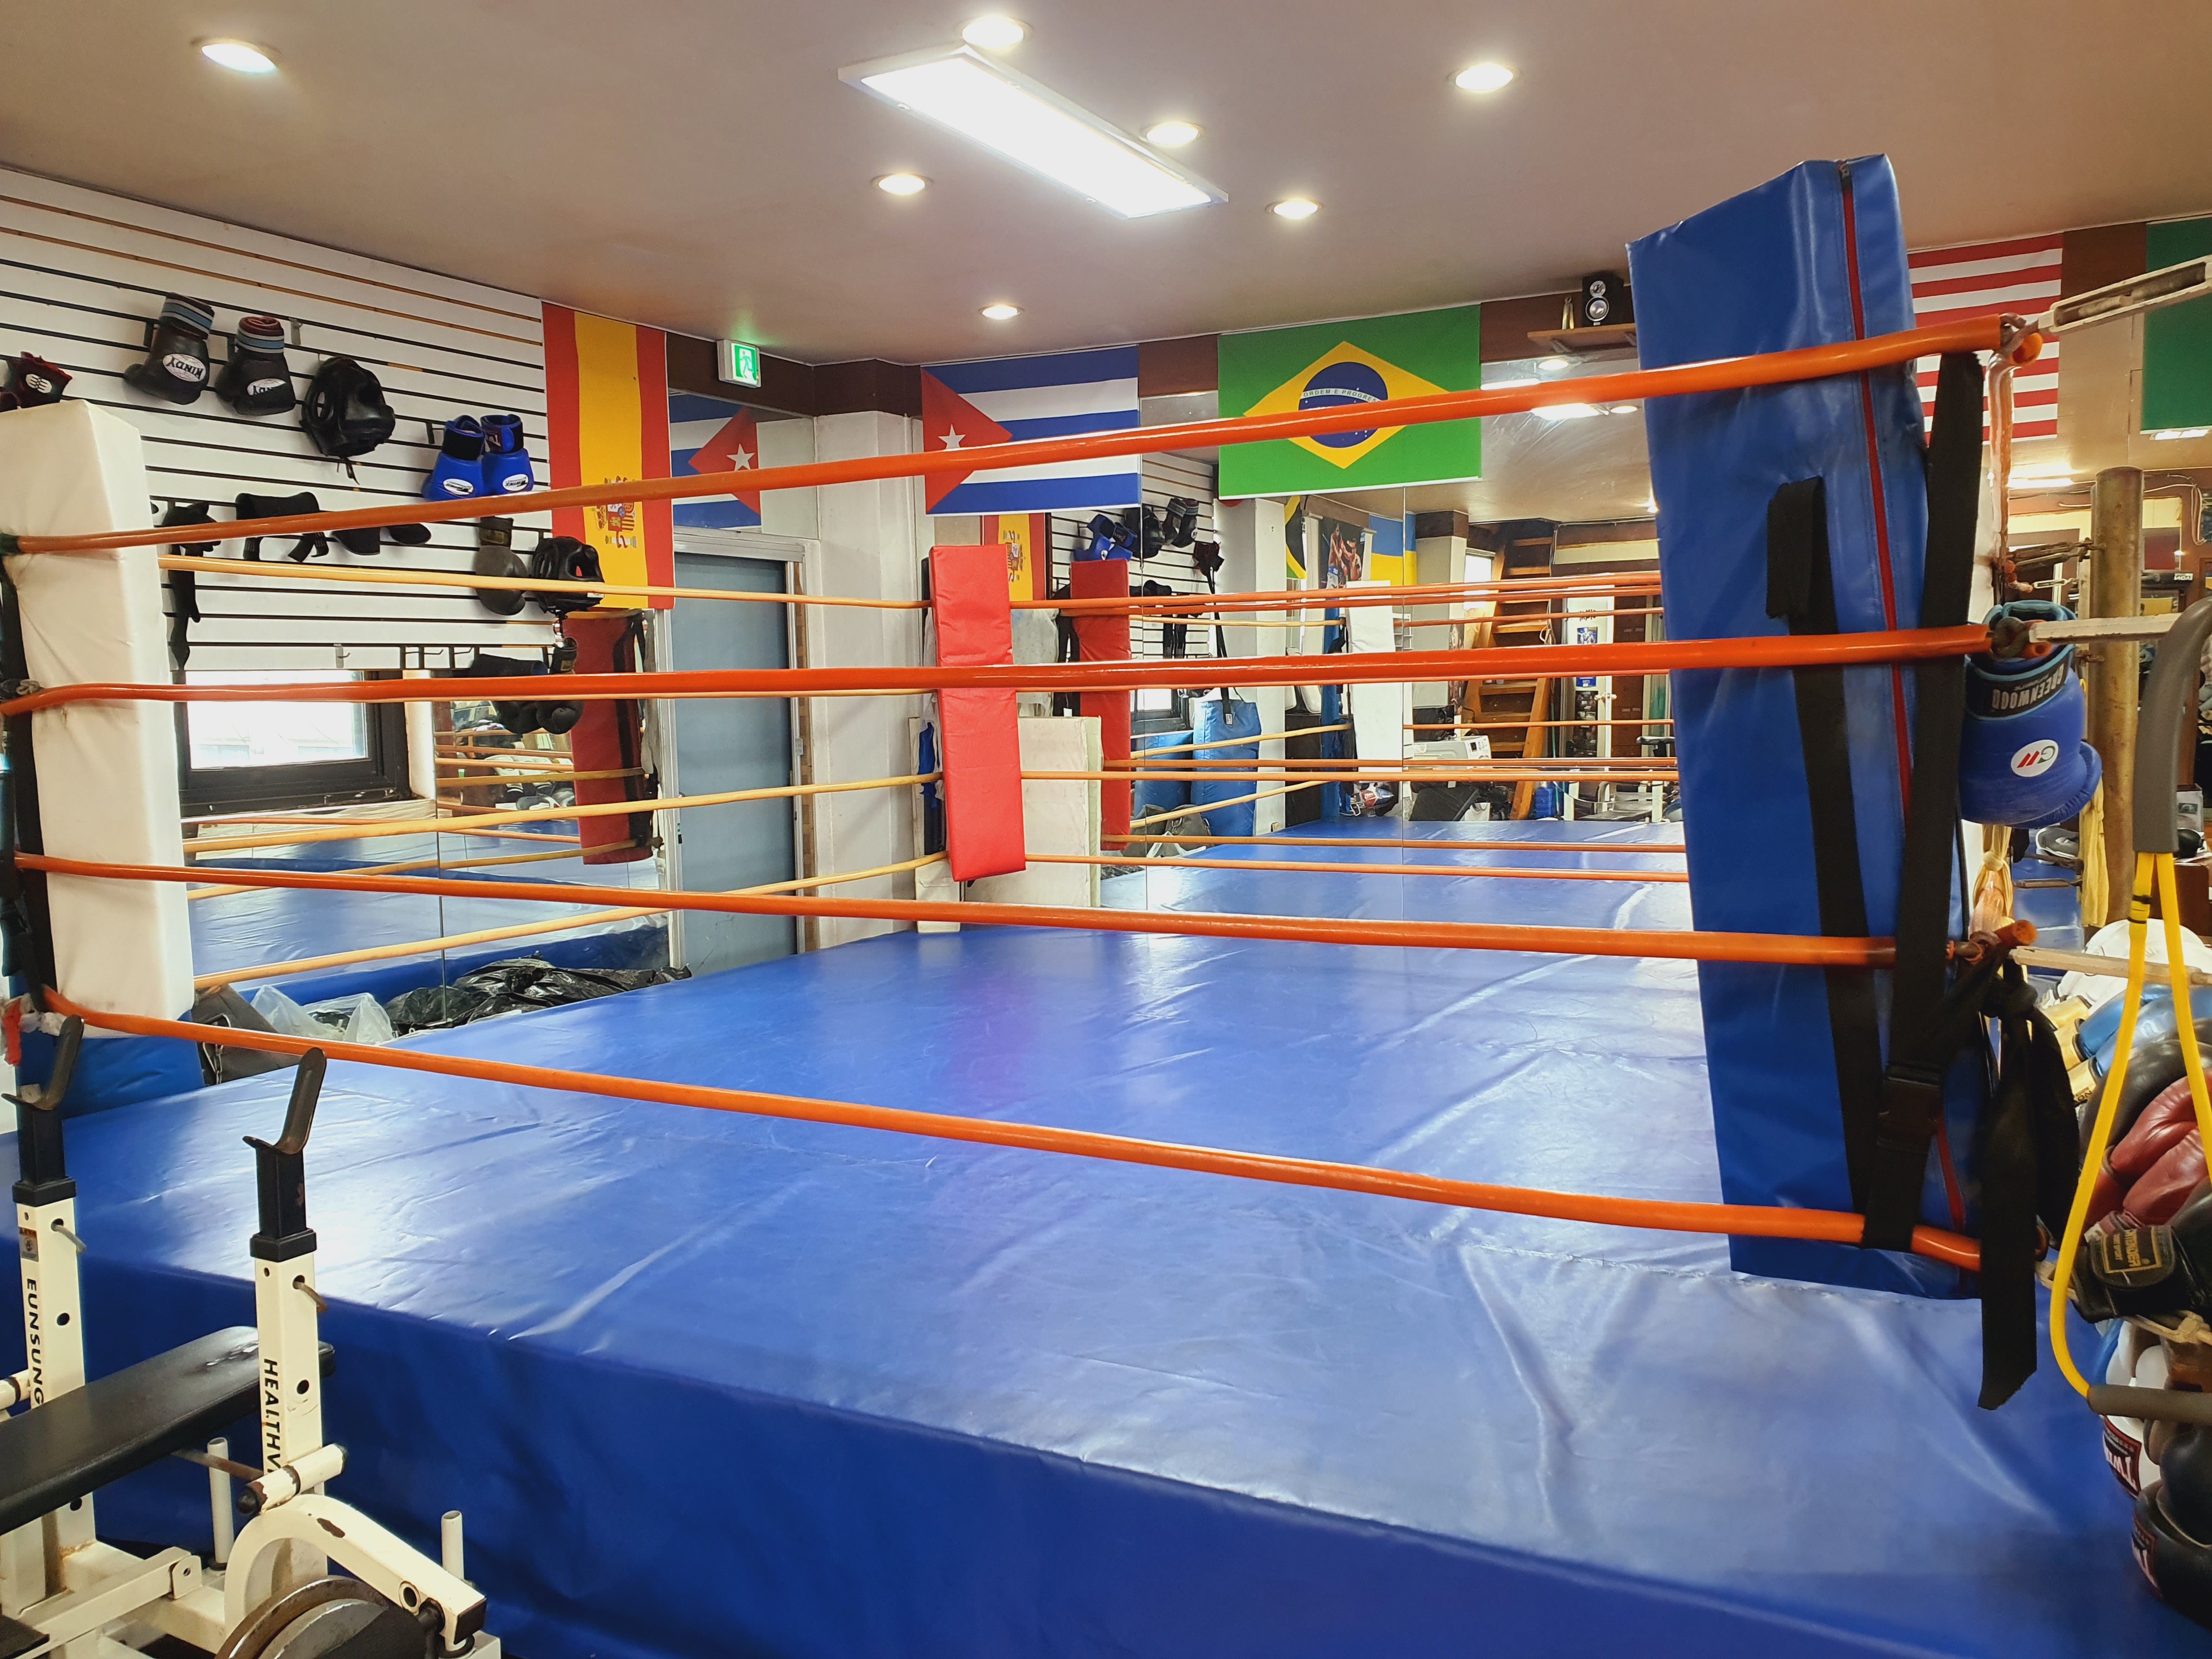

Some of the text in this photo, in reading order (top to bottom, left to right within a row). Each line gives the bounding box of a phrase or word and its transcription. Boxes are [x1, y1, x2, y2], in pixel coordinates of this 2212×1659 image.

[1342, 390, 1380, 403] PROGRES
[1992, 663, 2064, 709] GREENWOOD
[27, 1278, 44, 1404] EUNSUNG
